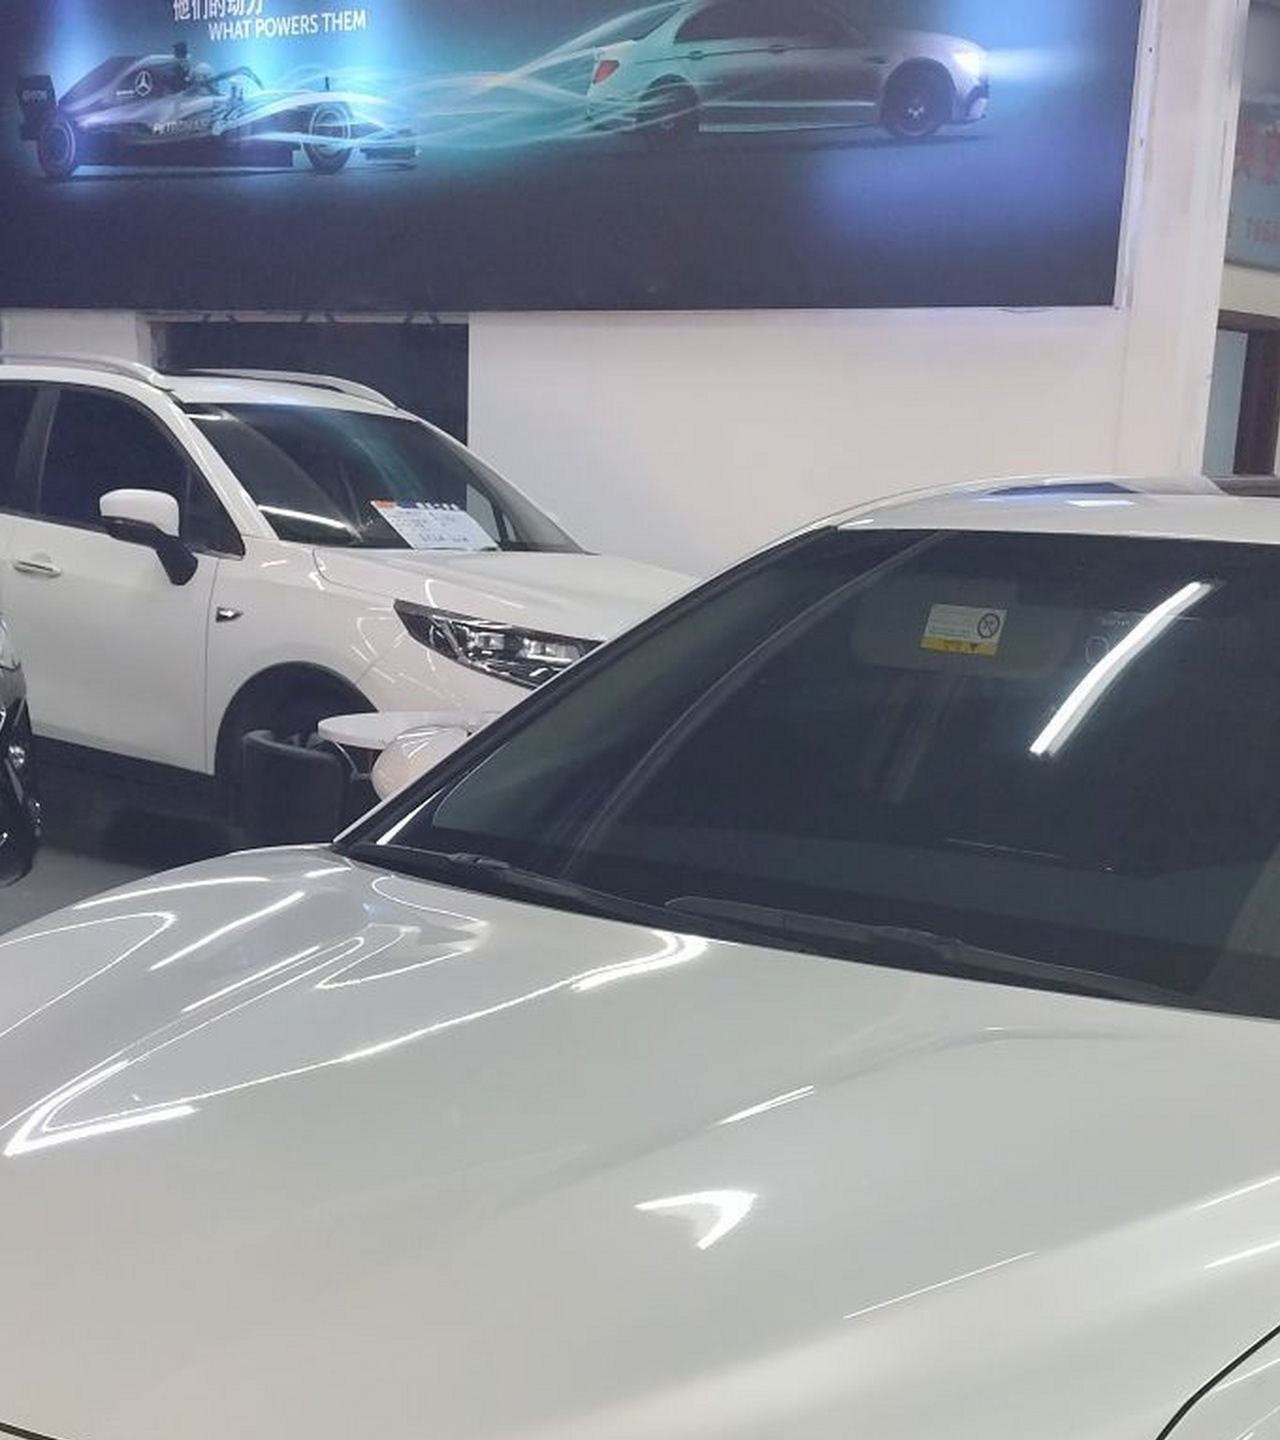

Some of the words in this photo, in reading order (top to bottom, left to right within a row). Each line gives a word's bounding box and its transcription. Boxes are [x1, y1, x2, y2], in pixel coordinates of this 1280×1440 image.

[209, 21, 251, 40] WHAT
[255, 15, 319, 37] POWERS
[322, 10, 366, 32] THEM
